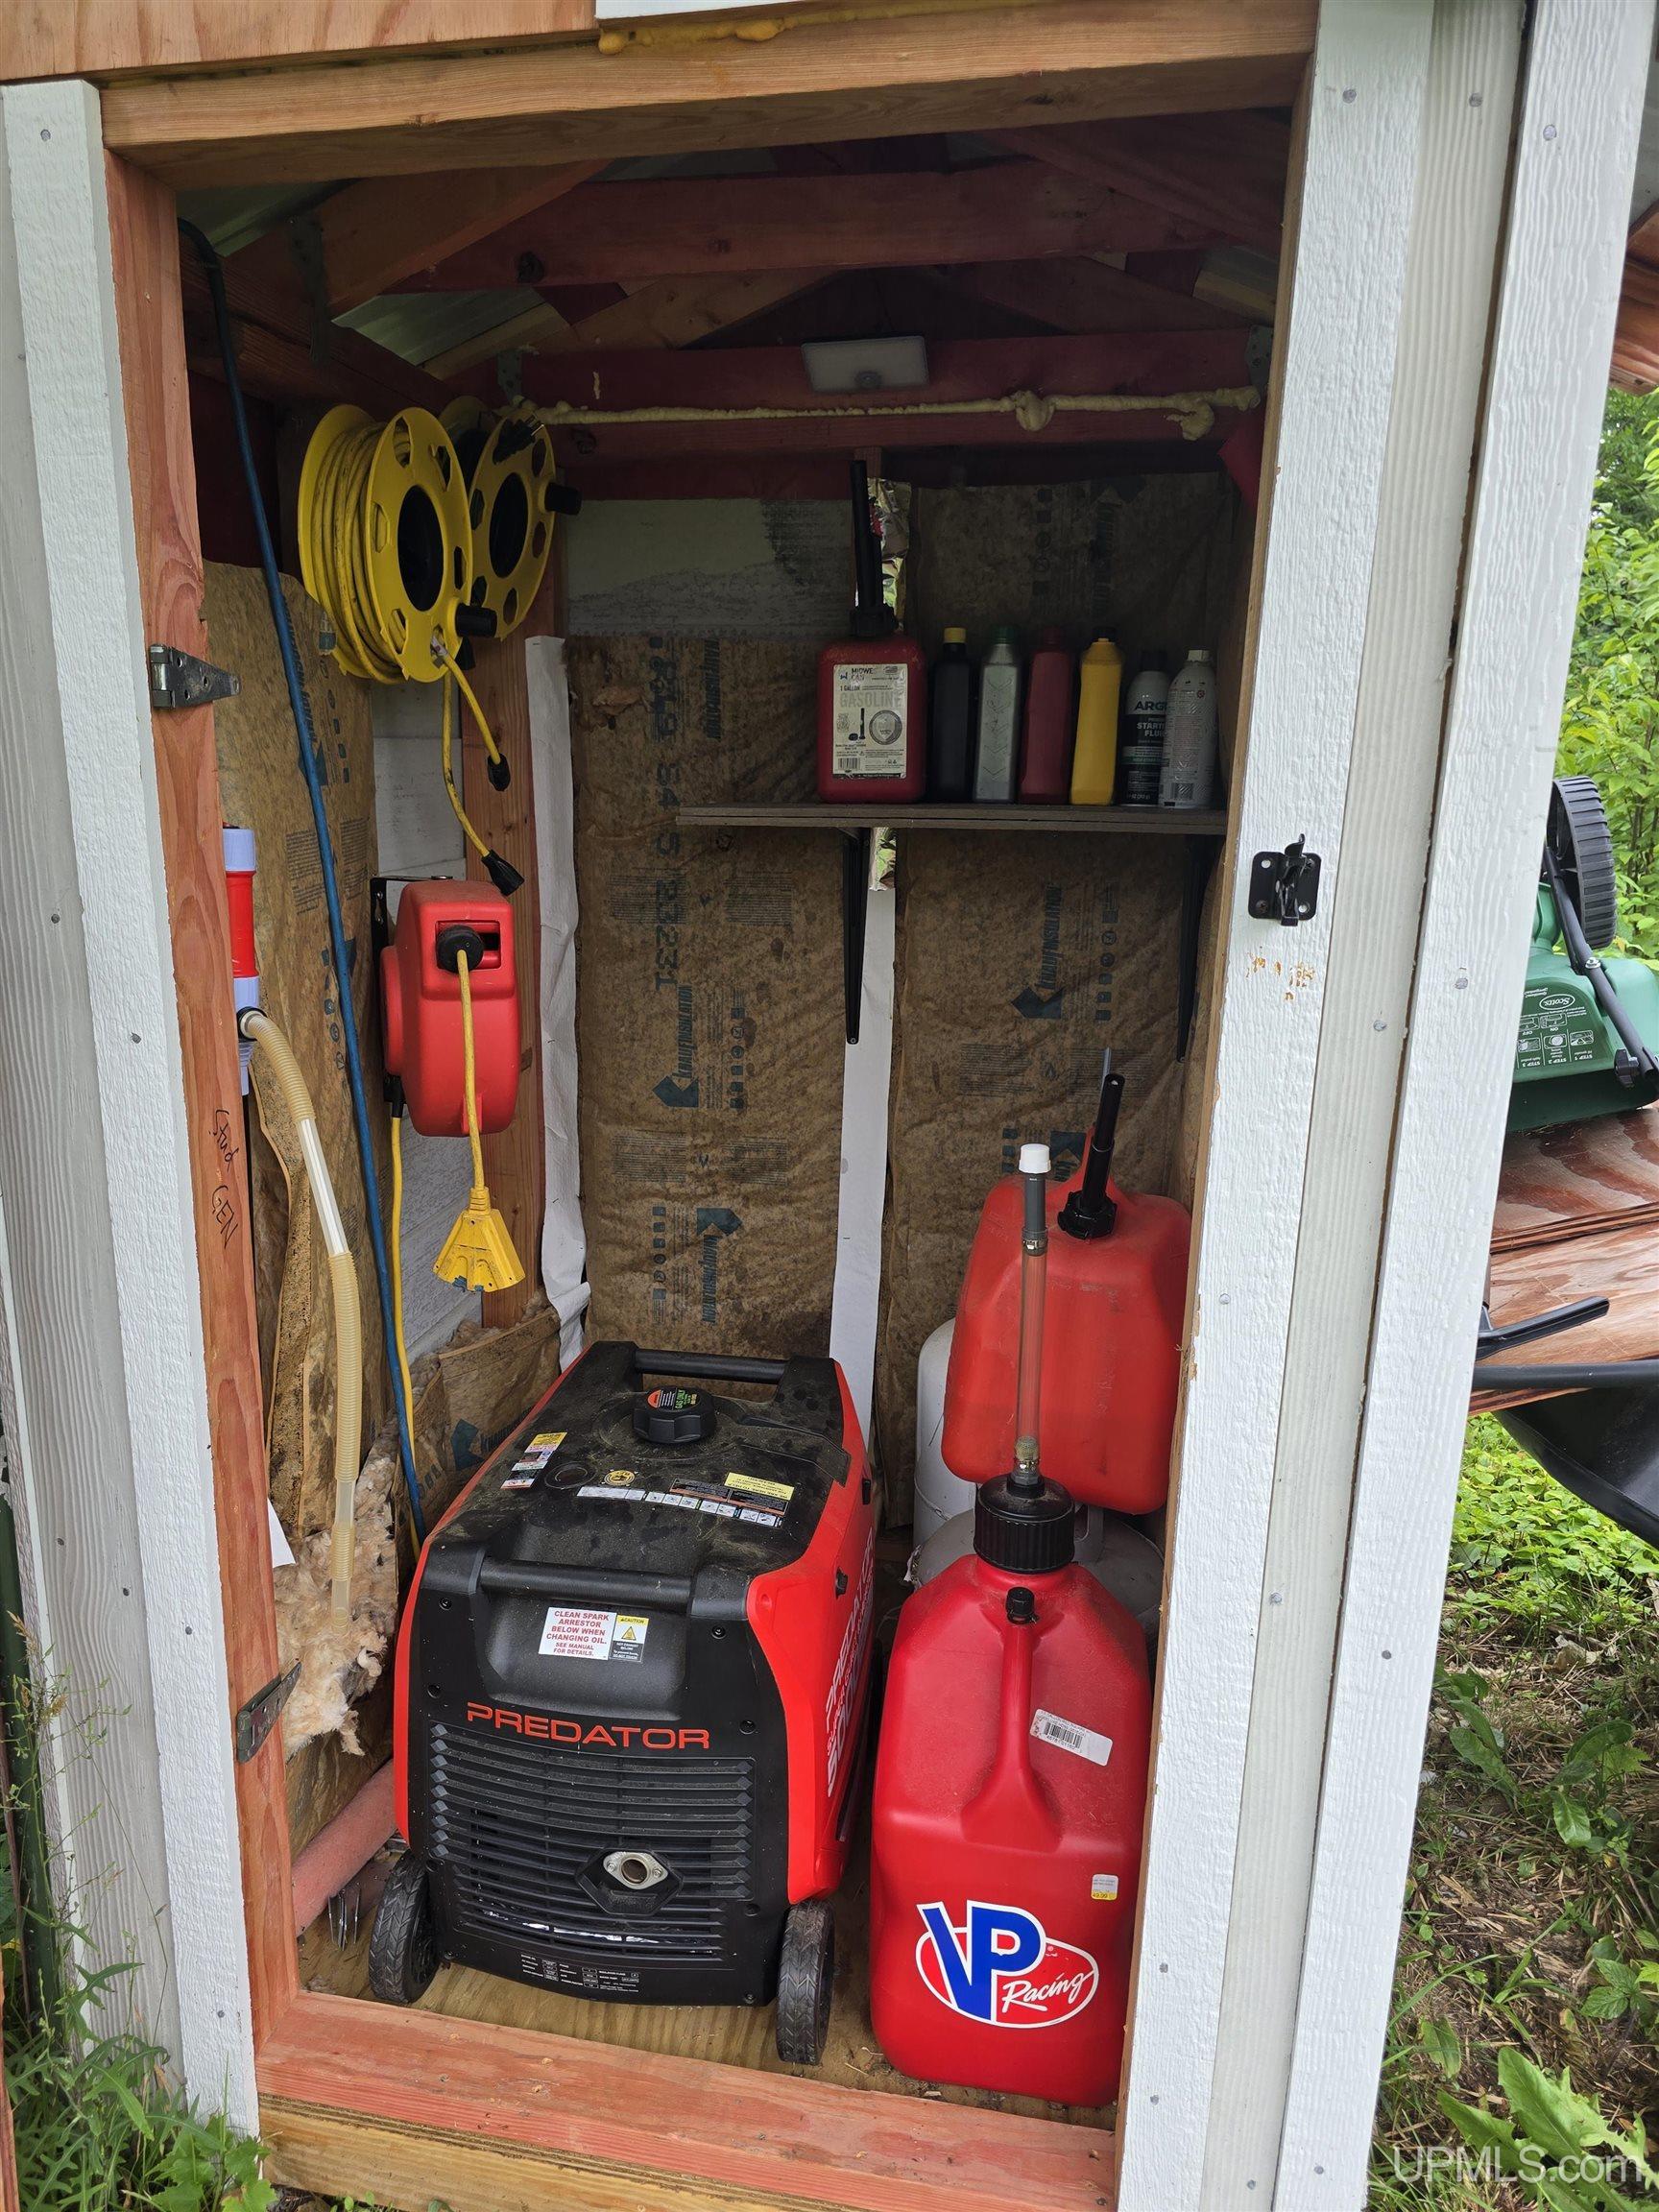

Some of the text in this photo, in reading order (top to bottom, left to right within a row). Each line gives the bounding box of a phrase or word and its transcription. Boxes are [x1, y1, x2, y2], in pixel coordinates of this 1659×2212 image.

[839, 690, 902, 709] GASOLINE
[553, 1610, 610, 1621] CLEAN SPARK
[558, 1618, 602, 1627] ARRESTOR
[546, 1633, 589, 1642] CHANGING
[551, 1625, 606, 1636] BELOW WHEN
[466, 1701, 710, 1750] PREDATOR
[917, 1900, 1046, 2023] VP
[1000, 1971, 1086, 2013] Racing
